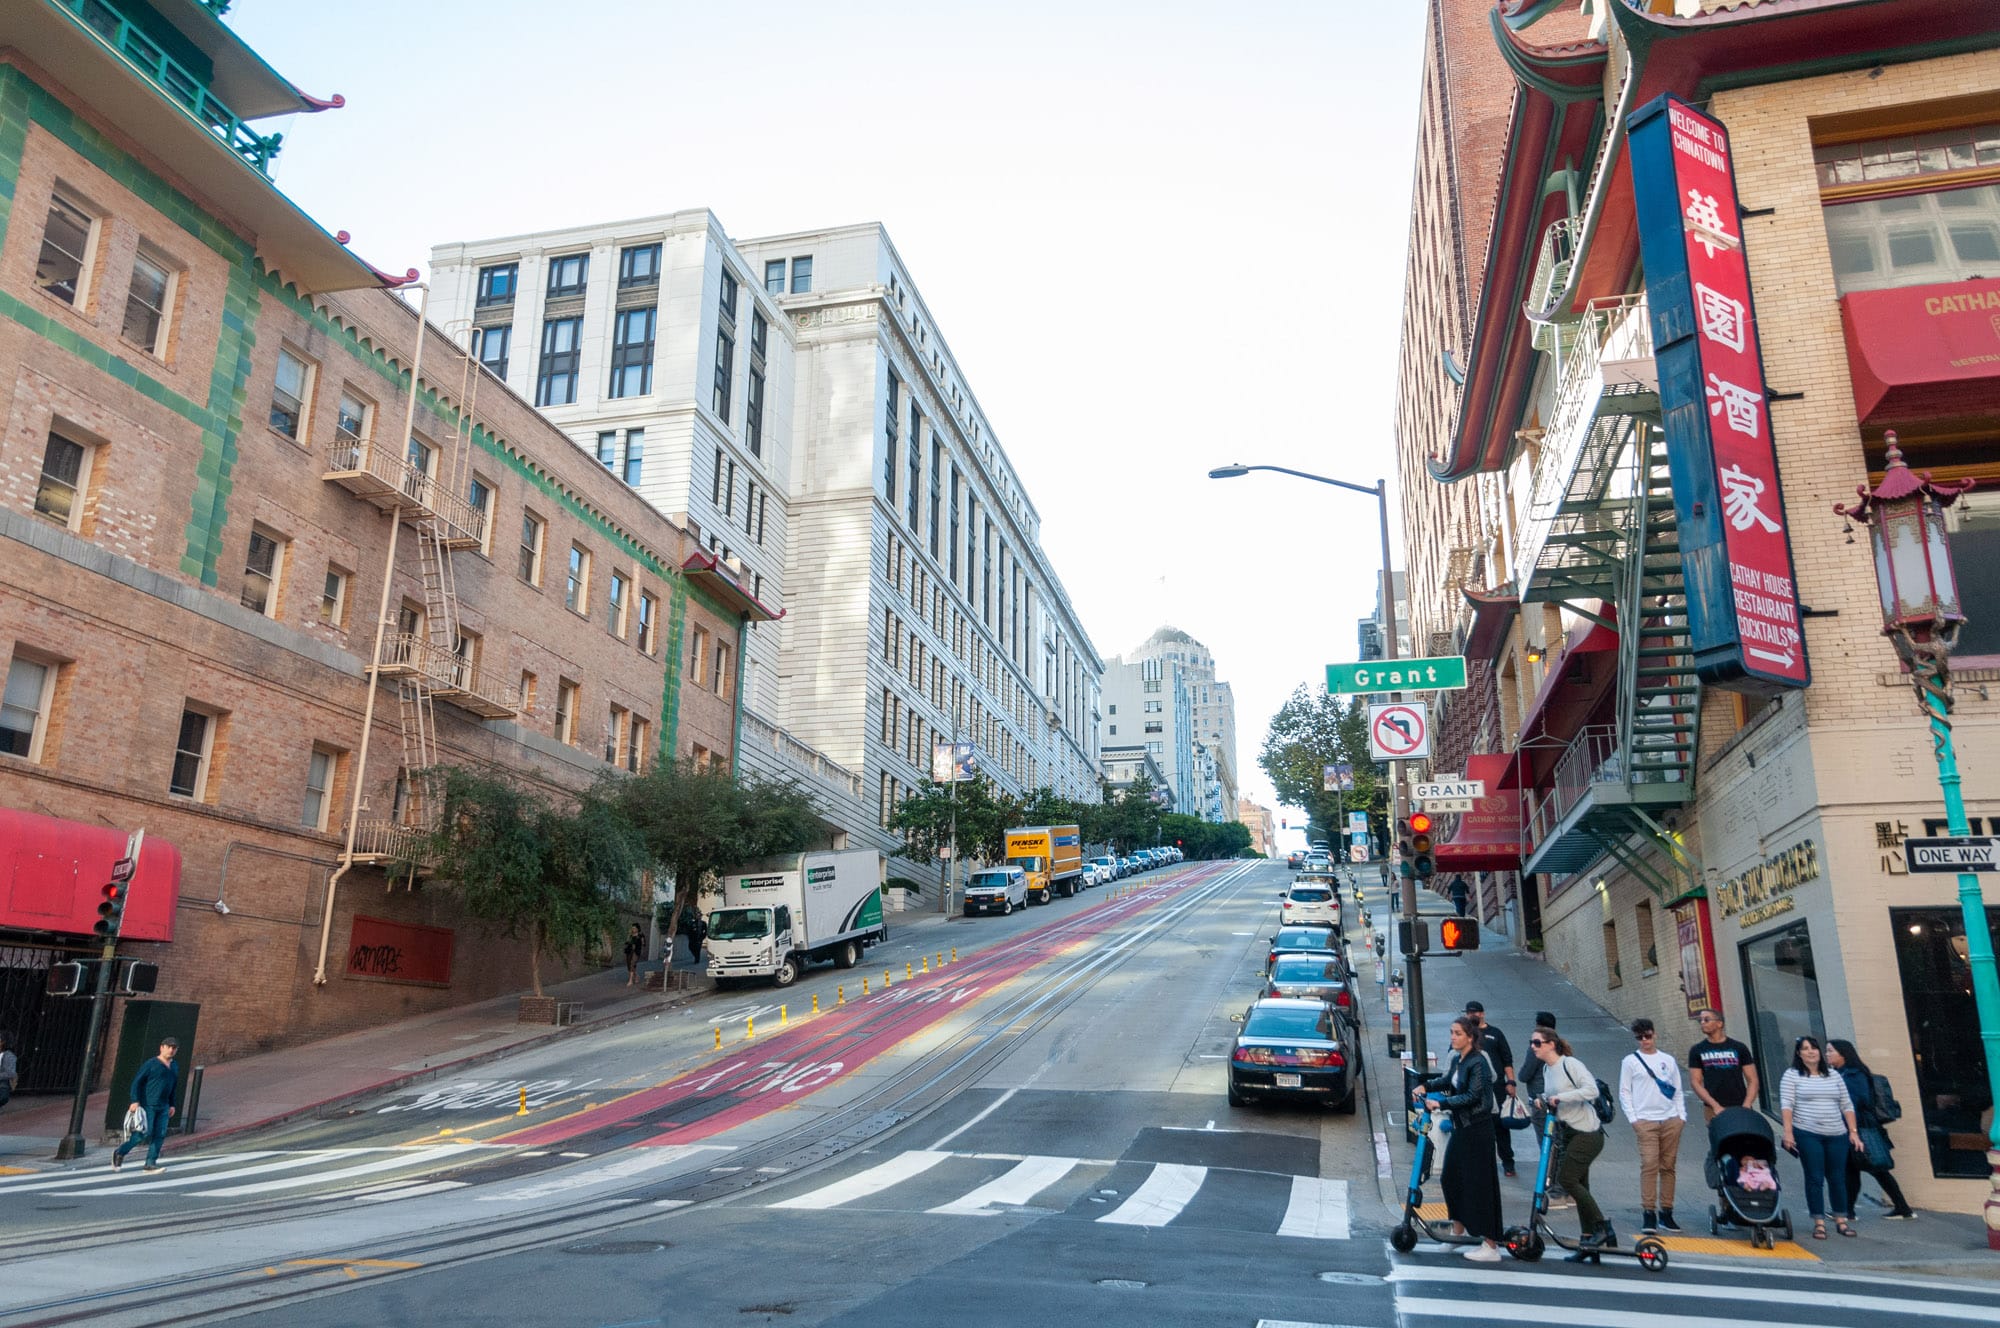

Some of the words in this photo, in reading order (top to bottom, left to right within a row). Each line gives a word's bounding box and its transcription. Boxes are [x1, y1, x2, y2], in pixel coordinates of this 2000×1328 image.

[1668, 107, 1711, 146] WELCOME
[1712, 131, 1725, 153] TO
[1673, 130, 1726, 173] CHINATOWN
[1925, 290, 2000, 316] CATHA
[1686, 189, 1782, 534] 華園酒家
[1729, 561, 1761, 590] CATHAY
[1762, 572, 1793, 599] HOUSE
[1733, 588, 1795, 624] RESTAURANT
[1736, 614, 1789, 648] COCKTAILS
[1354, 665, 1438, 687] Grant
[1417, 784, 1478, 797] GRANT
[1467, 815, 1496, 824] CATHAY
[1011, 839, 1045, 847] PENSKE
[1919, 848, 1953, 863] ONE
[1958, 848, 1992, 862] WAY
[743, 876, 784, 887] enterprise
[809, 867, 835, 881] enterprise
